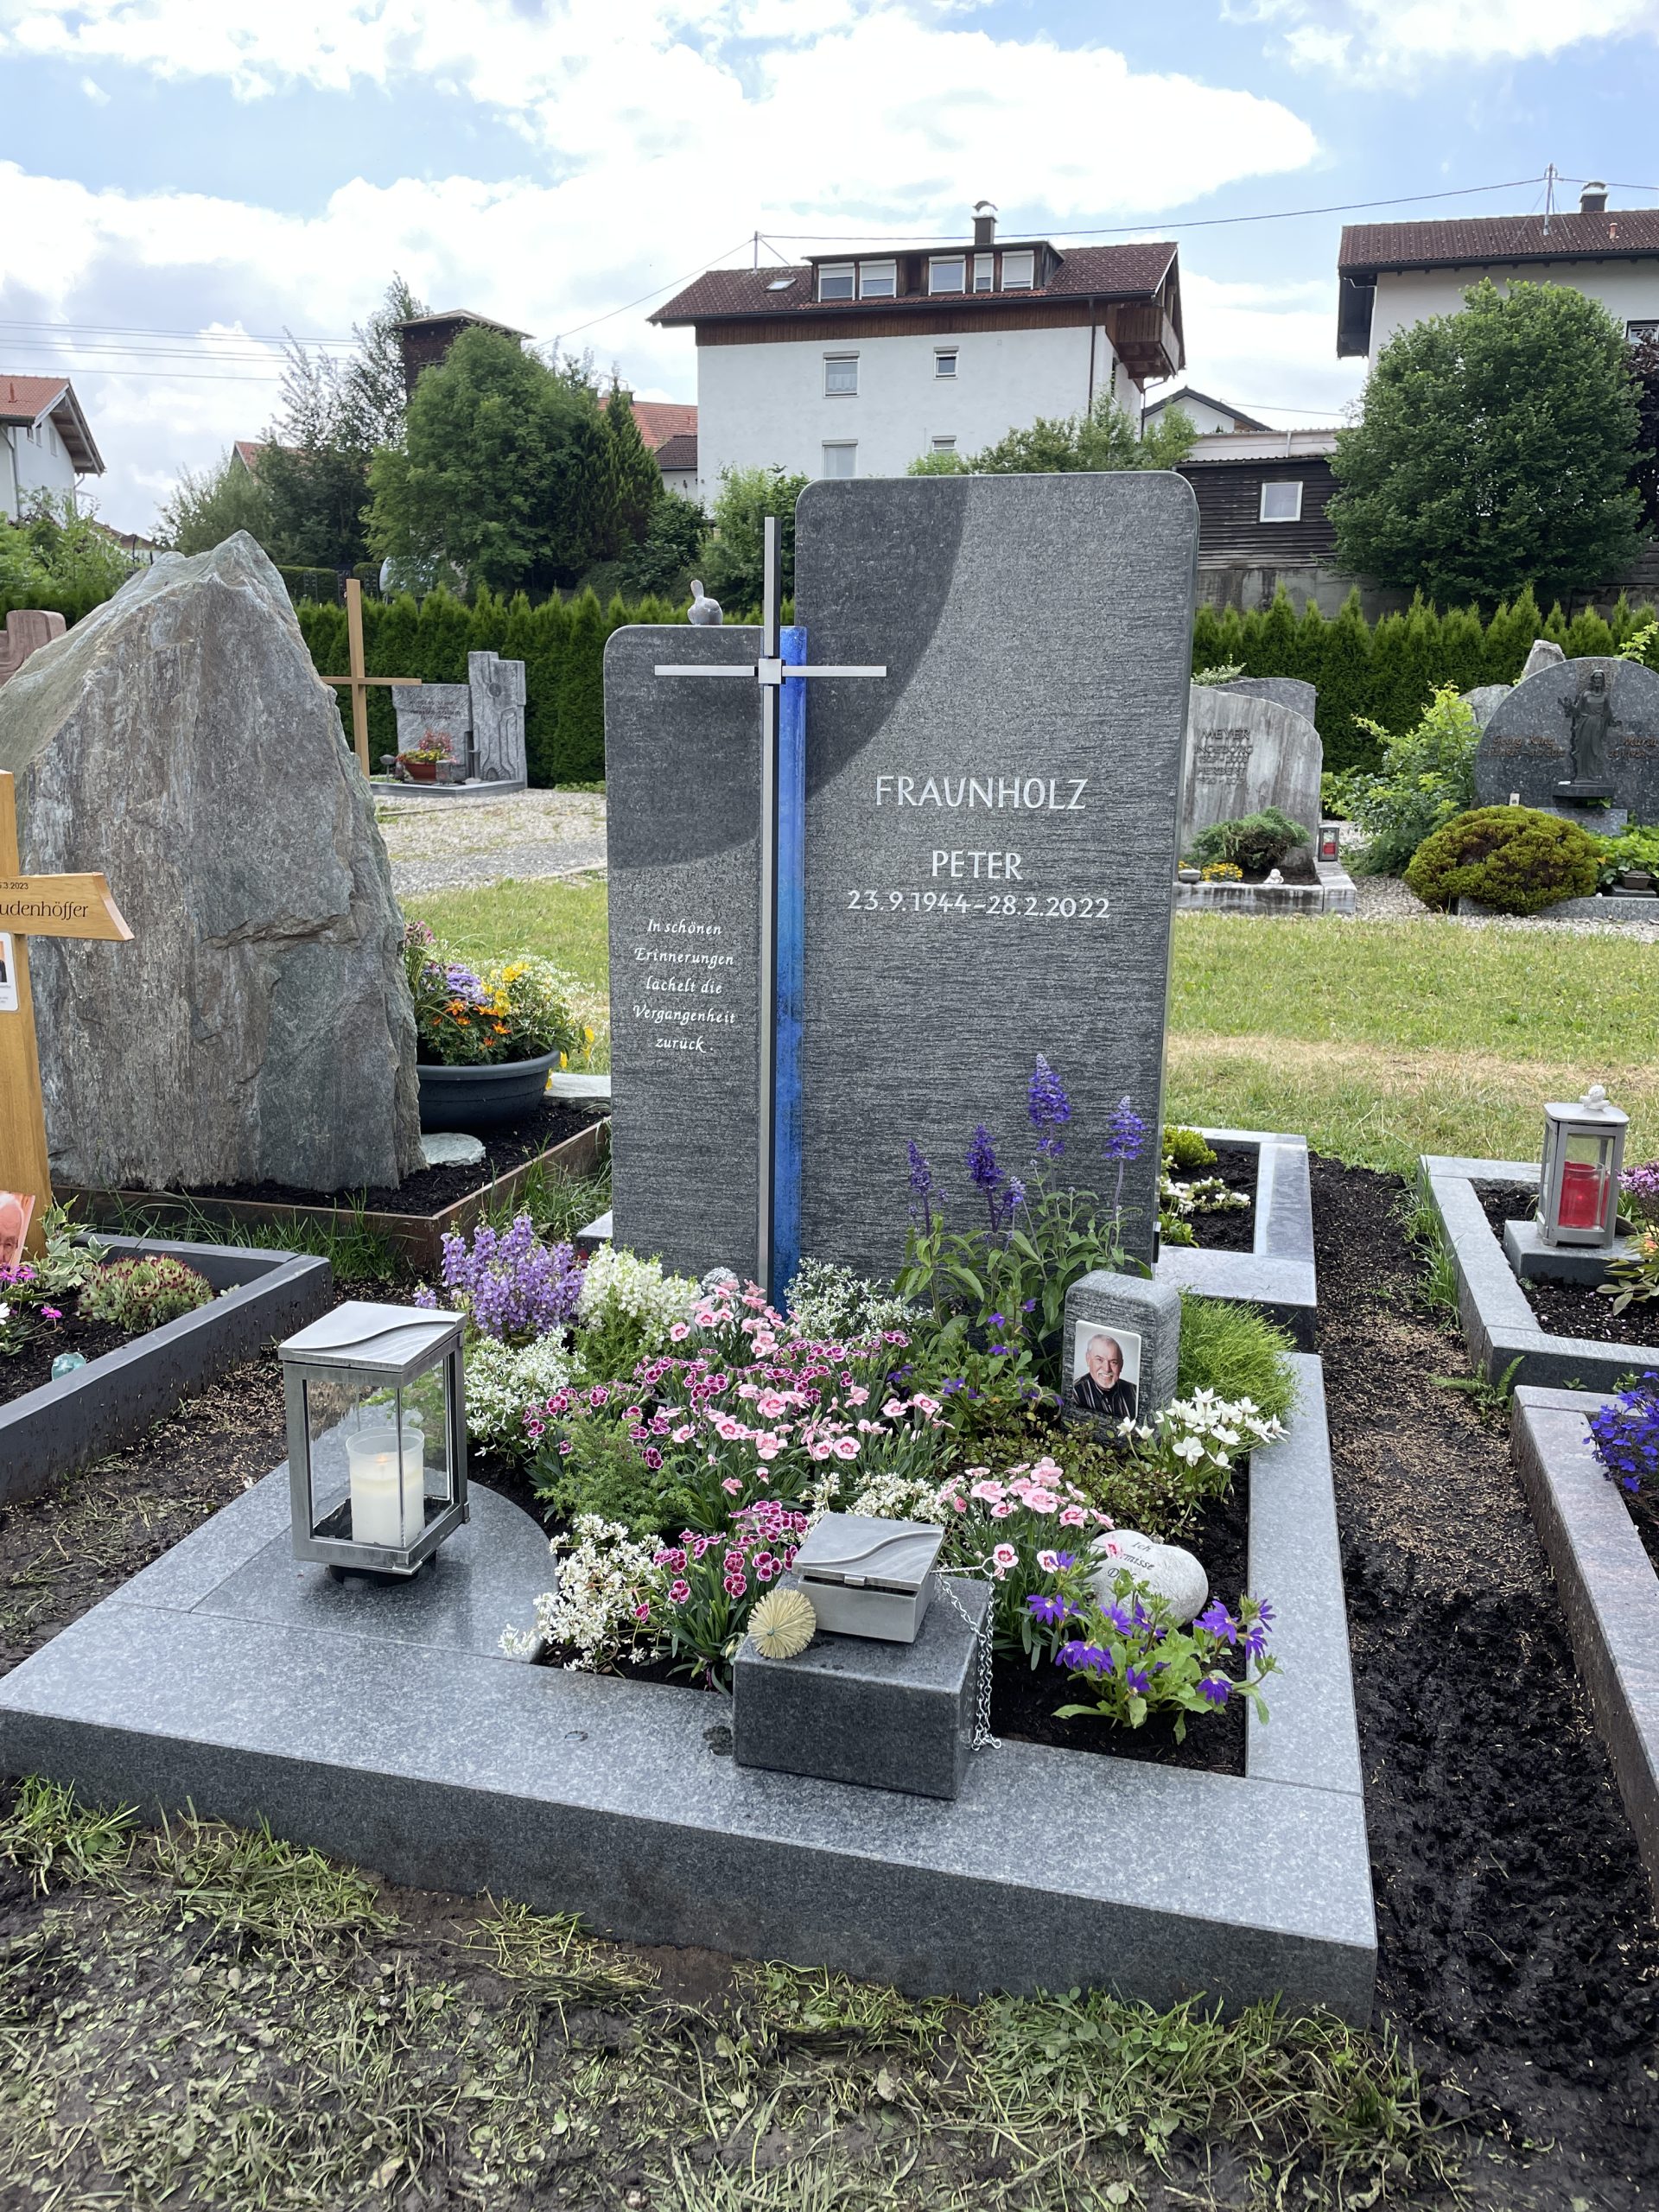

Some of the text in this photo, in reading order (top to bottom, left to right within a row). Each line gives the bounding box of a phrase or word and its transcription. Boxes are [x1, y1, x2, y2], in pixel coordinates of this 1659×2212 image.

[1202, 728, 1251, 741] MEYER
[1197, 766, 1248, 777] HERBERT
[875, 774, 1089, 810] FRAUNHOLZ
[931, 849, 1024, 880] PETER
[647, 918, 722, 936] In schönen
[634, 947, 734, 969] Erinnerungen
[701, 977, 723, 995] die
[632, 1003, 736, 1027] Vergangenheit
[1131, 1541, 1154, 1552] Ich
